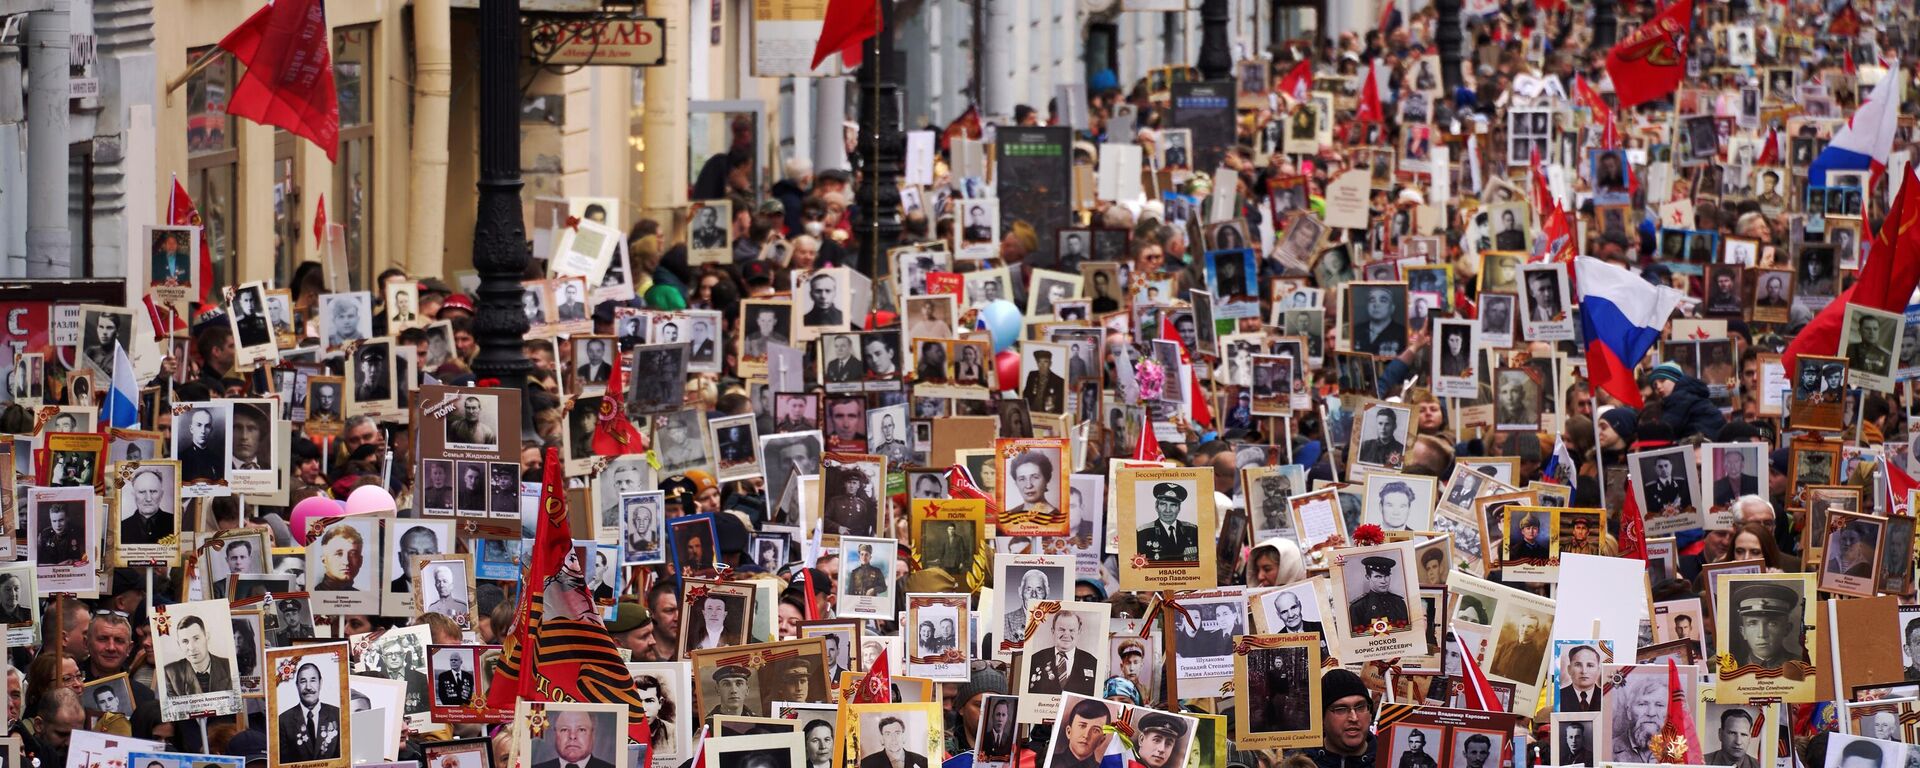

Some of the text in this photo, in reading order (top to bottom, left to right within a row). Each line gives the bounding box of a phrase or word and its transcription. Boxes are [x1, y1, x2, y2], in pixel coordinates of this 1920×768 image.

[541, 22, 652, 45] ОТЕЛЬ
[443, 451, 465, 460] Семья
[1135, 471, 1178, 480] Бессмертный
[1255, 636, 1299, 644] ЕССМЕРТНЫЙ
[1368, 638, 1397, 646] НОСКОВ
[1375, 643, 1412, 652] АЛЕКСЕЕВИЧ
[1436, 711, 1463, 719] Владимир
